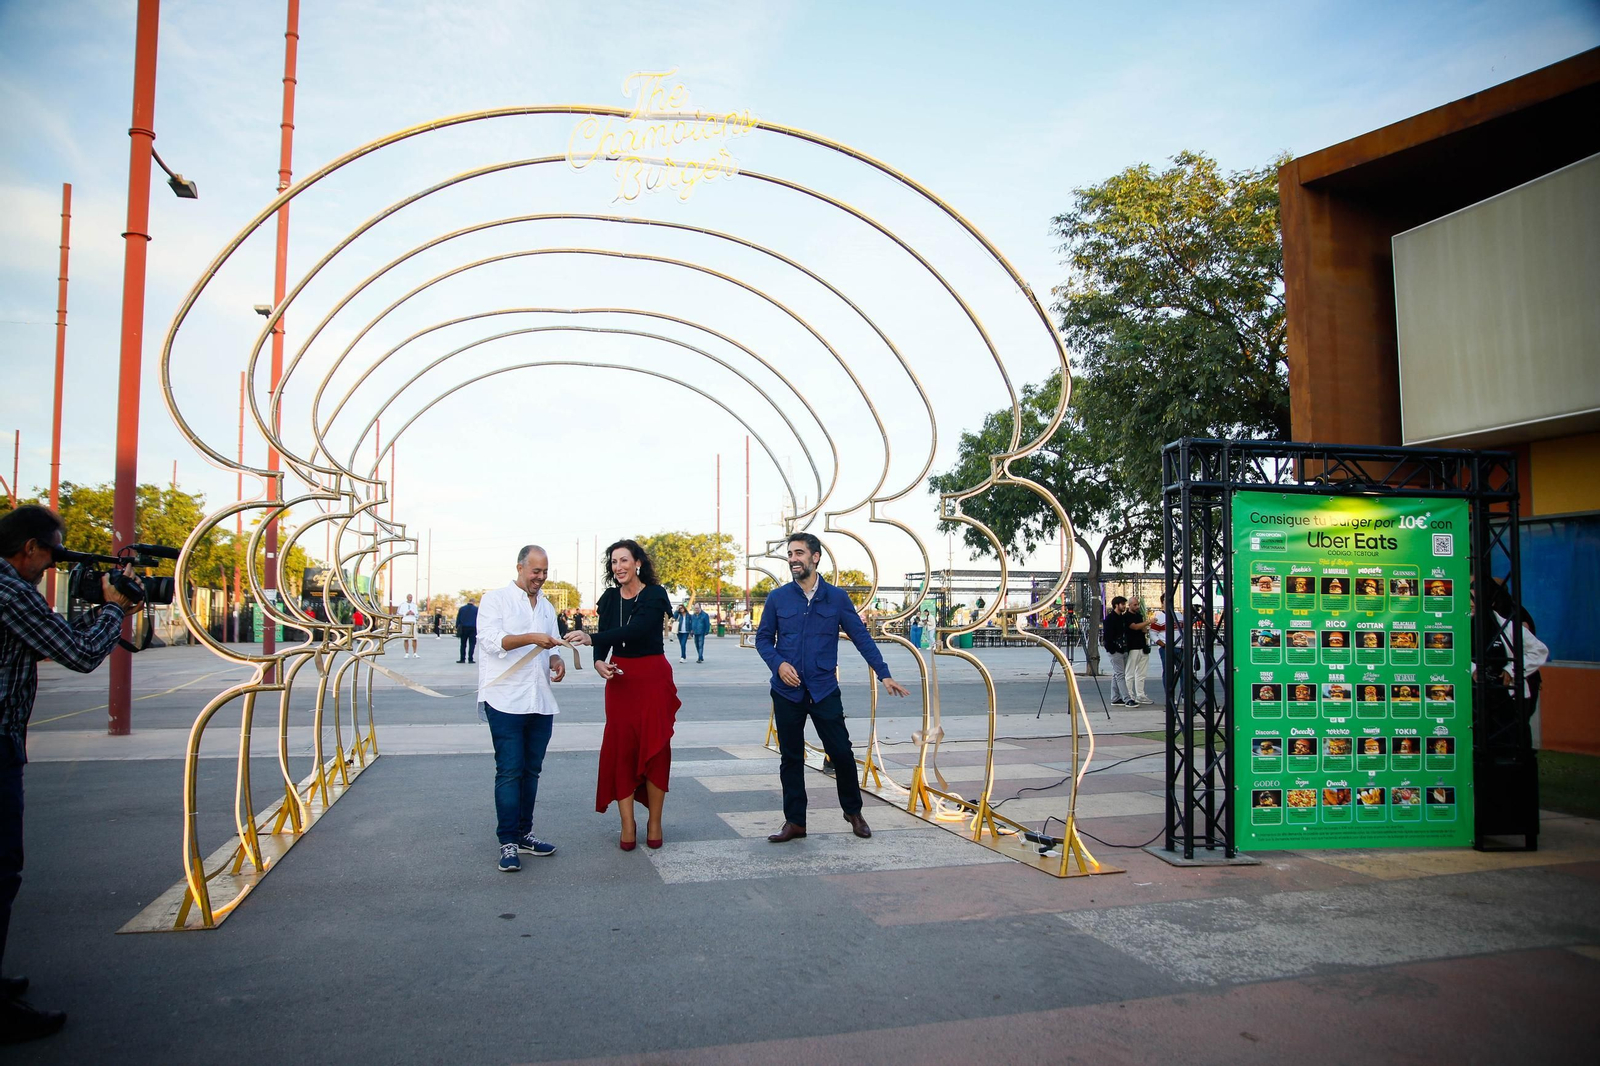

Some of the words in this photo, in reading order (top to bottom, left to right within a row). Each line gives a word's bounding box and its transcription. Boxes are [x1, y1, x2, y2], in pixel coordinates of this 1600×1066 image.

[624, 68, 689, 122] The
[568, 109, 757, 169] Champions
[611, 148, 738, 203] Burger
[1250, 511, 1311, 528] Consigue
[1313, 515, 1327, 526] tu
[1330, 516, 1372, 530] burger
[1373, 519, 1395, 530] por
[1430, 520, 1453, 530] con
[1307, 531, 1350, 549] Uber
[1354, 532, 1398, 550] Eats
[1325, 620, 1347, 628] RICO
[1253, 780, 1280, 788] GODEO
